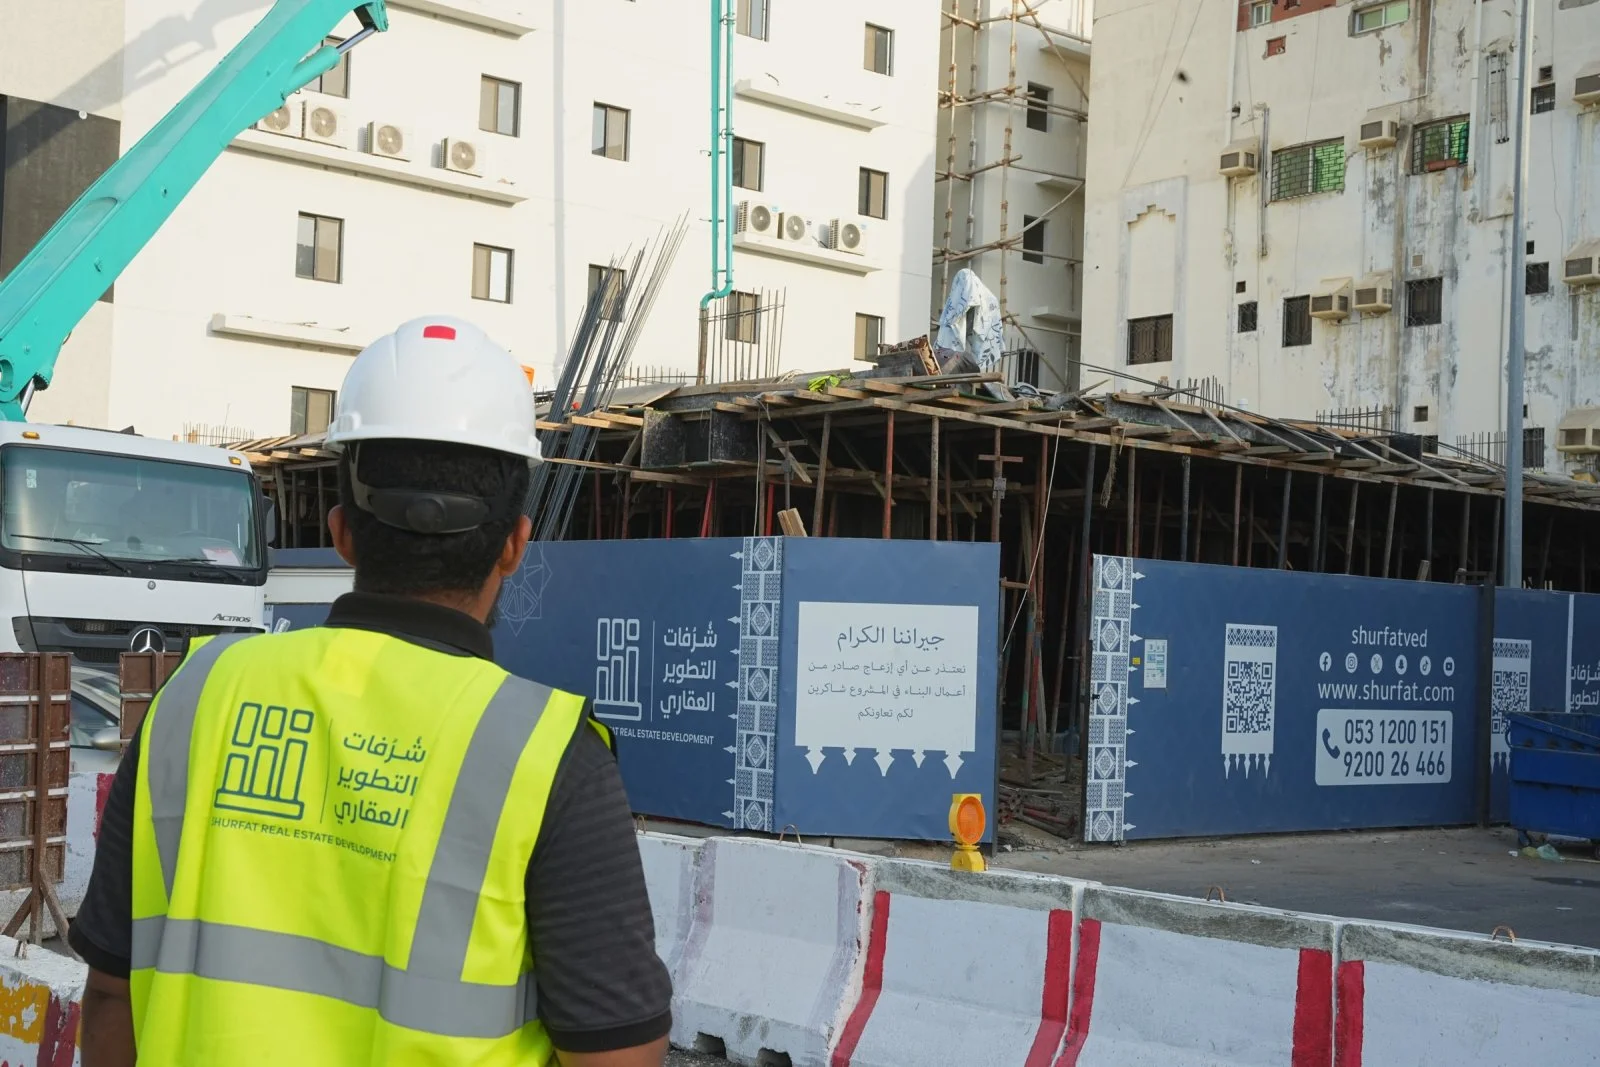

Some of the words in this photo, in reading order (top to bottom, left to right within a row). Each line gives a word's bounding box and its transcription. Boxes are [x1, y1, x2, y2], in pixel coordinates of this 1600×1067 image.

[837, 625, 885, 652] الكرام
[893, 626, 945, 652] جيراننا
[1351, 625, 1428, 648] shurfatved
[662, 658, 717, 684] التطوير
[808, 661, 828, 672] من
[831, 660, 860, 672] صادر
[863, 661, 893, 676] إزعاج
[896, 660, 908, 676] أي
[911, 664, 931, 675] عن
[935, 664, 967, 676] نعتذر
[807, 682, 847, 696] شاكرين
[850, 684, 889, 698] المشروع
[892, 685, 901, 700] في
[904, 684, 932, 699] البناء
[934, 684, 966, 697] أعمال
[1317, 680, 1455, 702] www.shurfat.com
[660, 690, 716, 719] العقاري
[857, 706, 893, 721] تعاونكم
[896, 708, 914, 723] لكم
[620, 727, 636, 738] REAL
[637, 729, 660, 740] ESTATE
[661, 731, 714, 745] DEVELOPMENT
[1344, 719, 1374, 744] 053
[1379, 719, 1417, 744] 1200
[1421, 720, 1447, 744] 151
[1343, 751, 1385, 777] 9200
[1390, 751, 1410, 777] 26
[1415, 751, 1446, 776] 466
[337, 766, 418, 797] التطوير
[334, 800, 409, 829] العقاري
[261, 823, 290, 837] REAL
[293, 829, 334, 845] ESTATE
[335, 836, 398, 863] DEVELOPMENT
